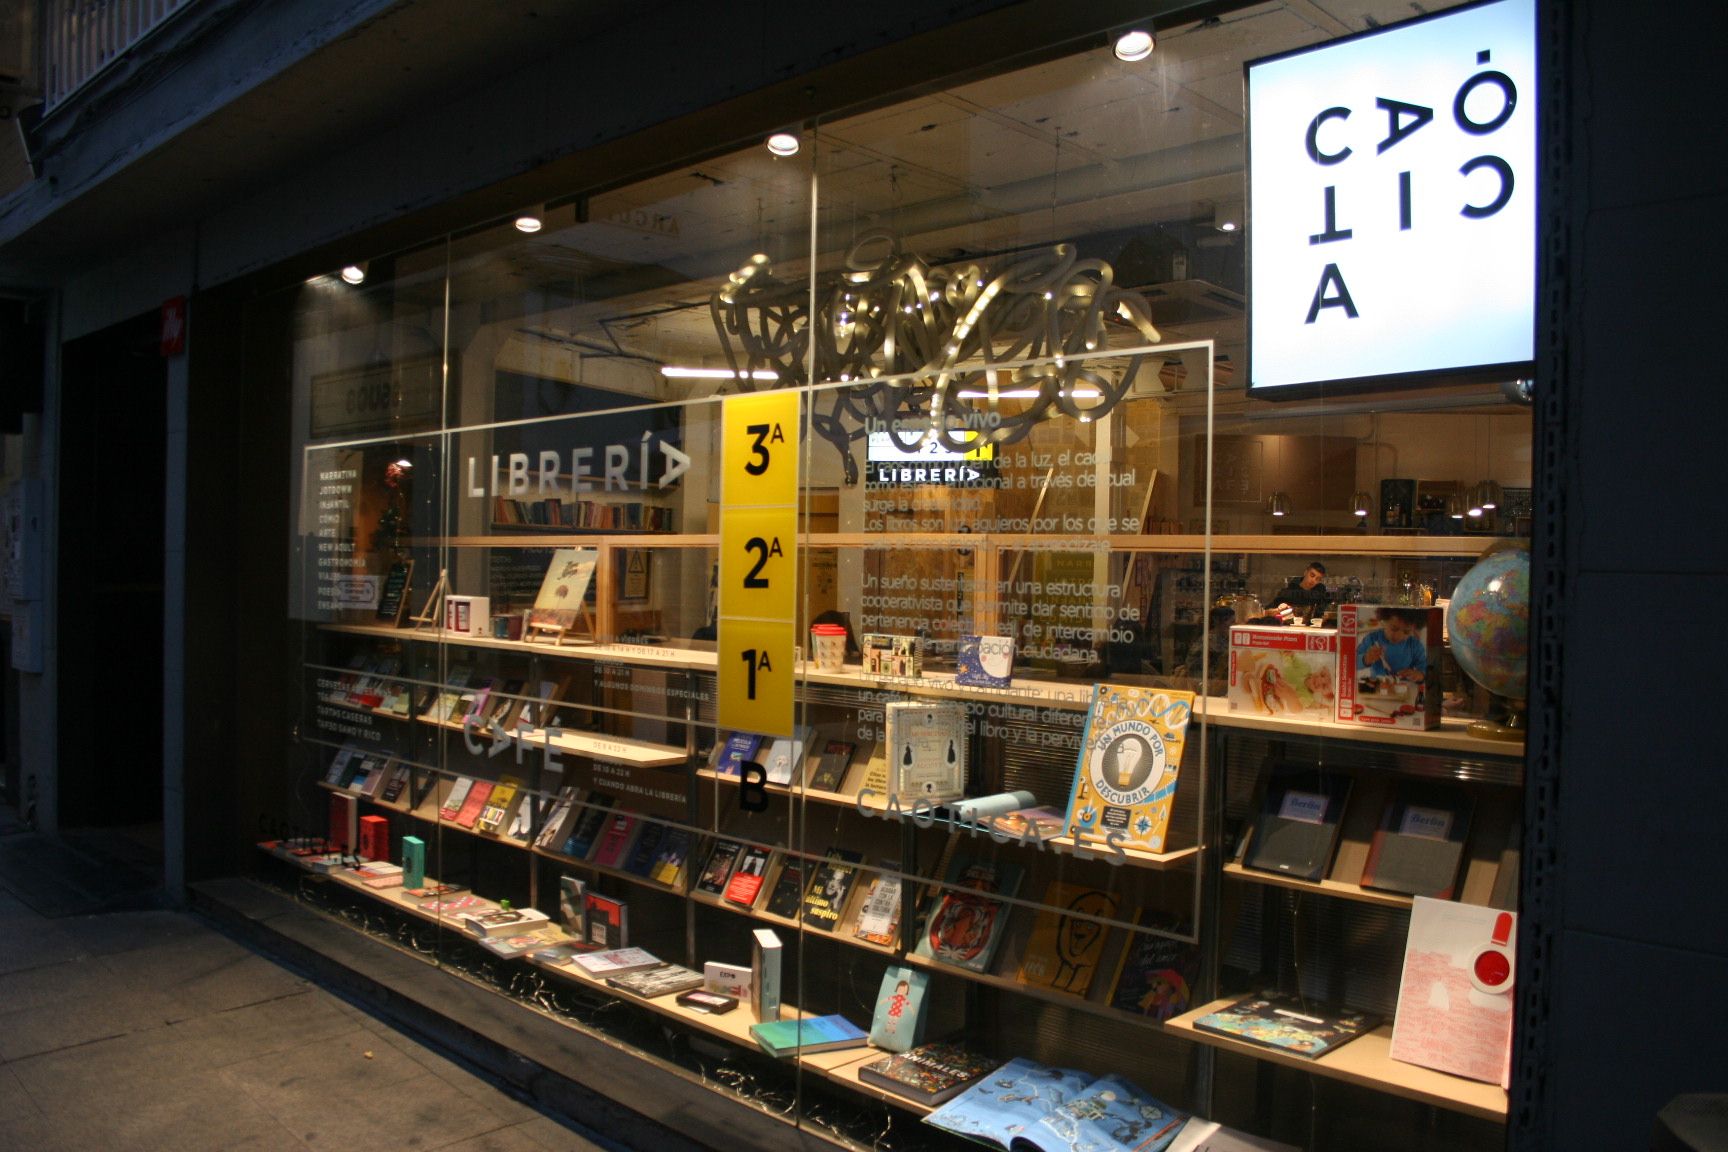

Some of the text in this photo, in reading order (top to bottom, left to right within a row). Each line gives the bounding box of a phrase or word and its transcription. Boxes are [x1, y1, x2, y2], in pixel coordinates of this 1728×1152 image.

[865, 416, 886, 436] Un
[963, 411, 1001, 430] vivo
[468, 430, 692, 498] LIBRERÍA
[993, 452, 1012, 468] de
[1016, 451, 1028, 467] la
[1031, 450, 1054, 469] luz,
[1058, 448, 1071, 466] el
[1075, 445, 1113, 467] cal
[319, 469, 358, 481] NARRATIVA
[878, 465, 981, 482] LIBRERÍA
[1016, 478, 1026, 489] a
[1031, 471, 1073, 489] través
[1106, 468, 1136, 487] cual
[863, 498, 896, 514] surge
[898, 498, 909, 511] la
[318, 528, 337, 538] ARTE
[863, 516, 884, 531] Los
[886, 515, 918, 531] libros
[921, 517, 944, 531] son
[972, 516, 1029, 534] agujeros
[1033, 516, 1058, 534] por
[1063, 514, 1084, 531] los
[1087, 516, 1117, 533] qe
[1121, 516, 1140, 531] se
[860, 573, 878, 589] Un
[880, 574, 917, 591] sueño
[920, 575, 992, 592] sustenta
[996, 579, 1012, 593] en
[1016, 580, 1041, 595] una
[861, 593, 943, 612] cooperativista
[946, 597, 973, 615] que
[1031, 599, 1055, 616] dar
[1118, 603, 1141, 622] de
[860, 613, 930, 632] pertenencia
[932, 617, 990, 634] colectia
[1023, 620, 1042, 637] de
[1046, 622, 1134, 644] intercambio
[937, 637, 1019, 657] partación
[1023, 643, 1101, 665] ciudadana.
[667, 687, 710, 701] ESPECIALES
[857, 708, 884, 723] para
[981, 719, 1009, 739] libro
[1026, 725, 1040, 742] la
[939, 697, 985, 716] esacio
[987, 701, 1038, 721] cultural
[1041, 705, 1106, 730] diferene
[857, 724, 873, 741] de
[1097, 721, 1164, 758] UN MUNDO POR
[599, 778, 625, 791] CUANDO
[740, 760, 769, 813] B
[1095, 778, 1151, 805] DESCUBRIR
[809, 907, 839, 921] suspiro
[899, 1051, 971, 1079] ANIMALES
